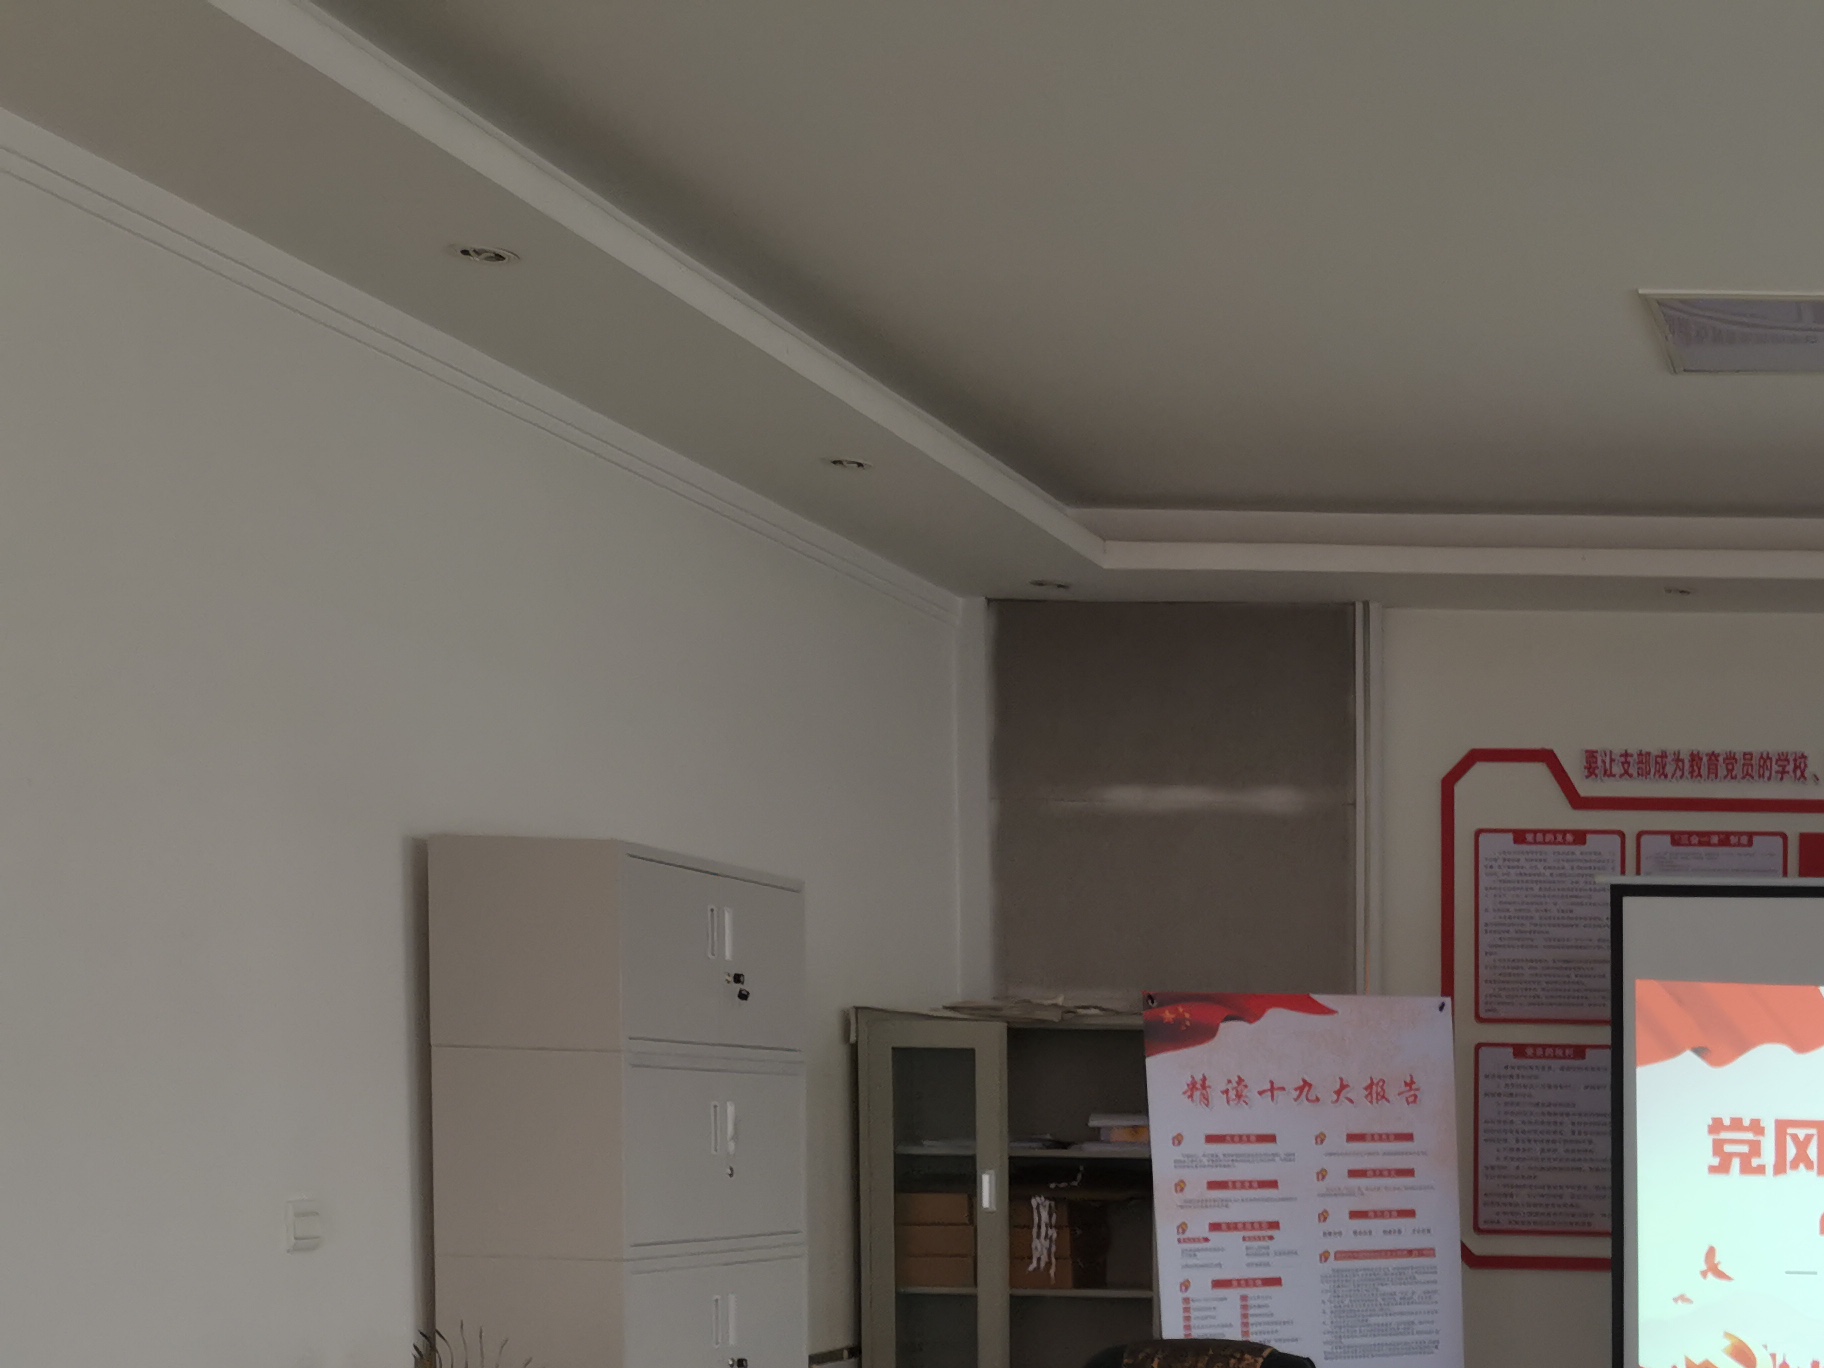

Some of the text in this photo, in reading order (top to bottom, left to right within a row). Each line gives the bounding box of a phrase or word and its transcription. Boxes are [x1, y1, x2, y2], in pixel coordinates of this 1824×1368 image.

[1182, 1073, 1421, 1107] 精读十九大报告
